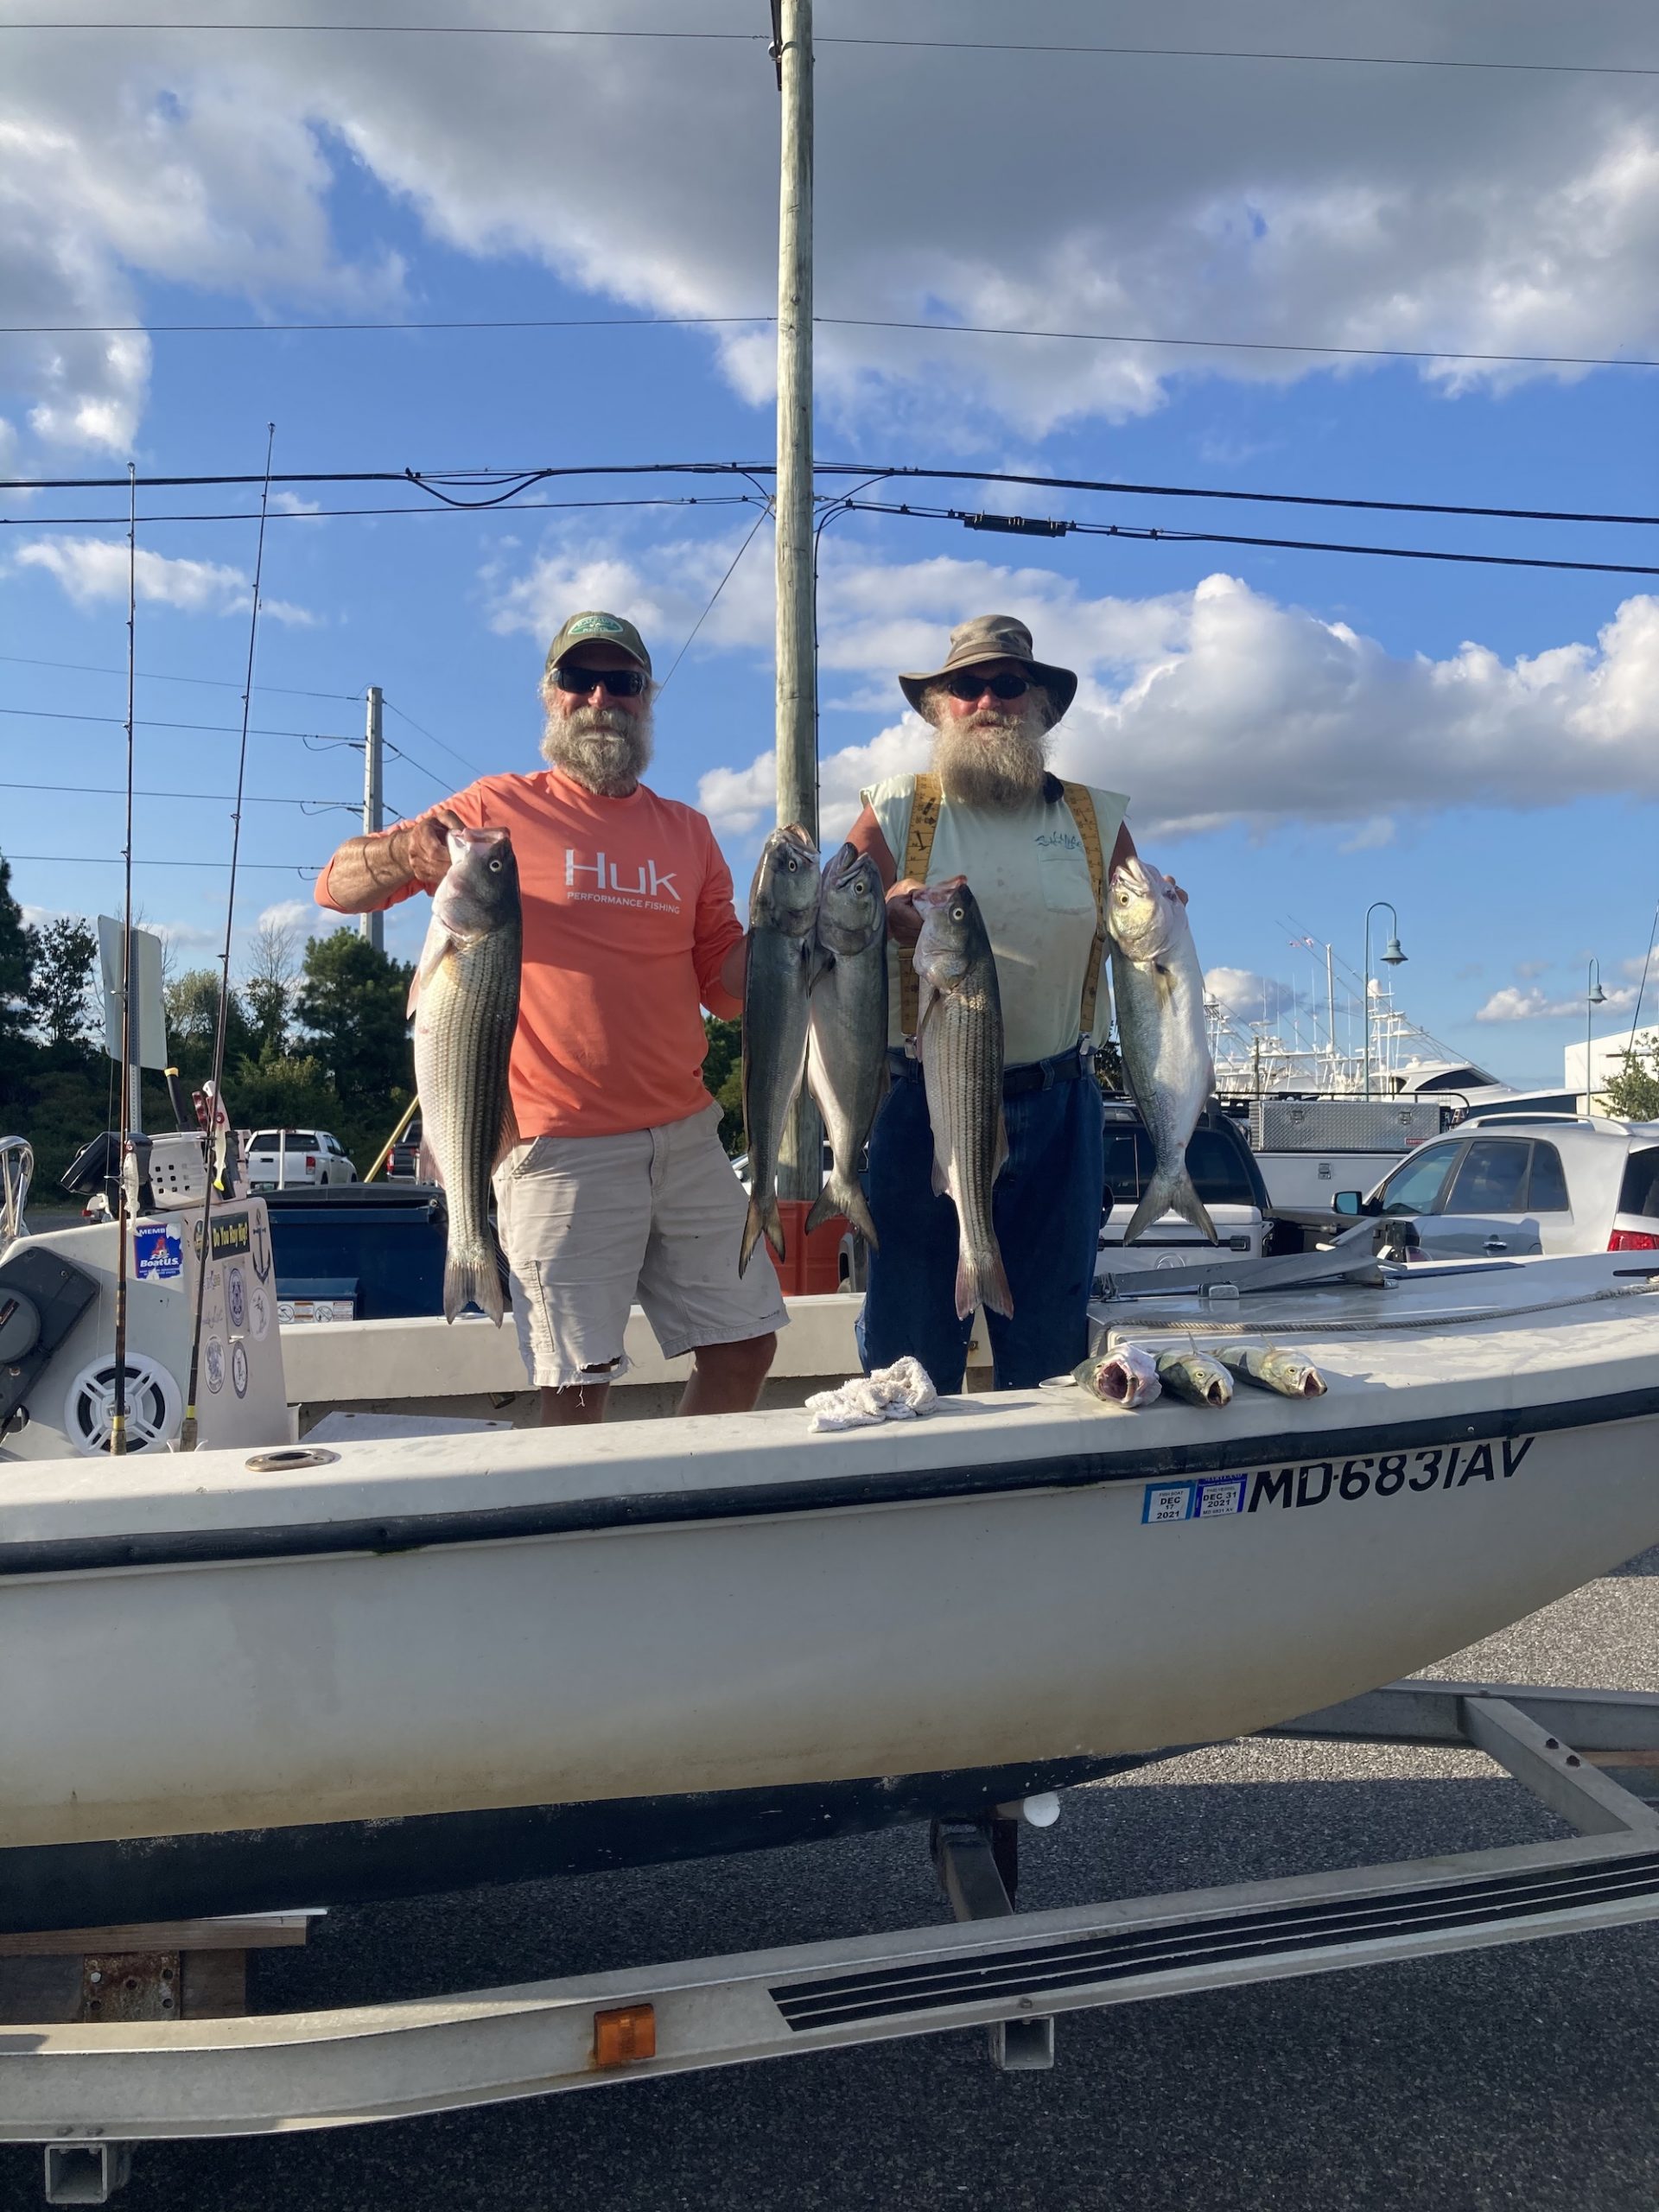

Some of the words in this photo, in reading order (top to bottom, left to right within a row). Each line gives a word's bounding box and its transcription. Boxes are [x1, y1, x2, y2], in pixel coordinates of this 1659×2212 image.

[567, 892, 643, 908] PERFORMANCE
[644, 900, 680, 914] FISHING
[1160, 1497, 1181, 1505] DEC
[1207, 1499, 1230, 1508] 2021
[1156, 1510, 1179, 1520] 2021
